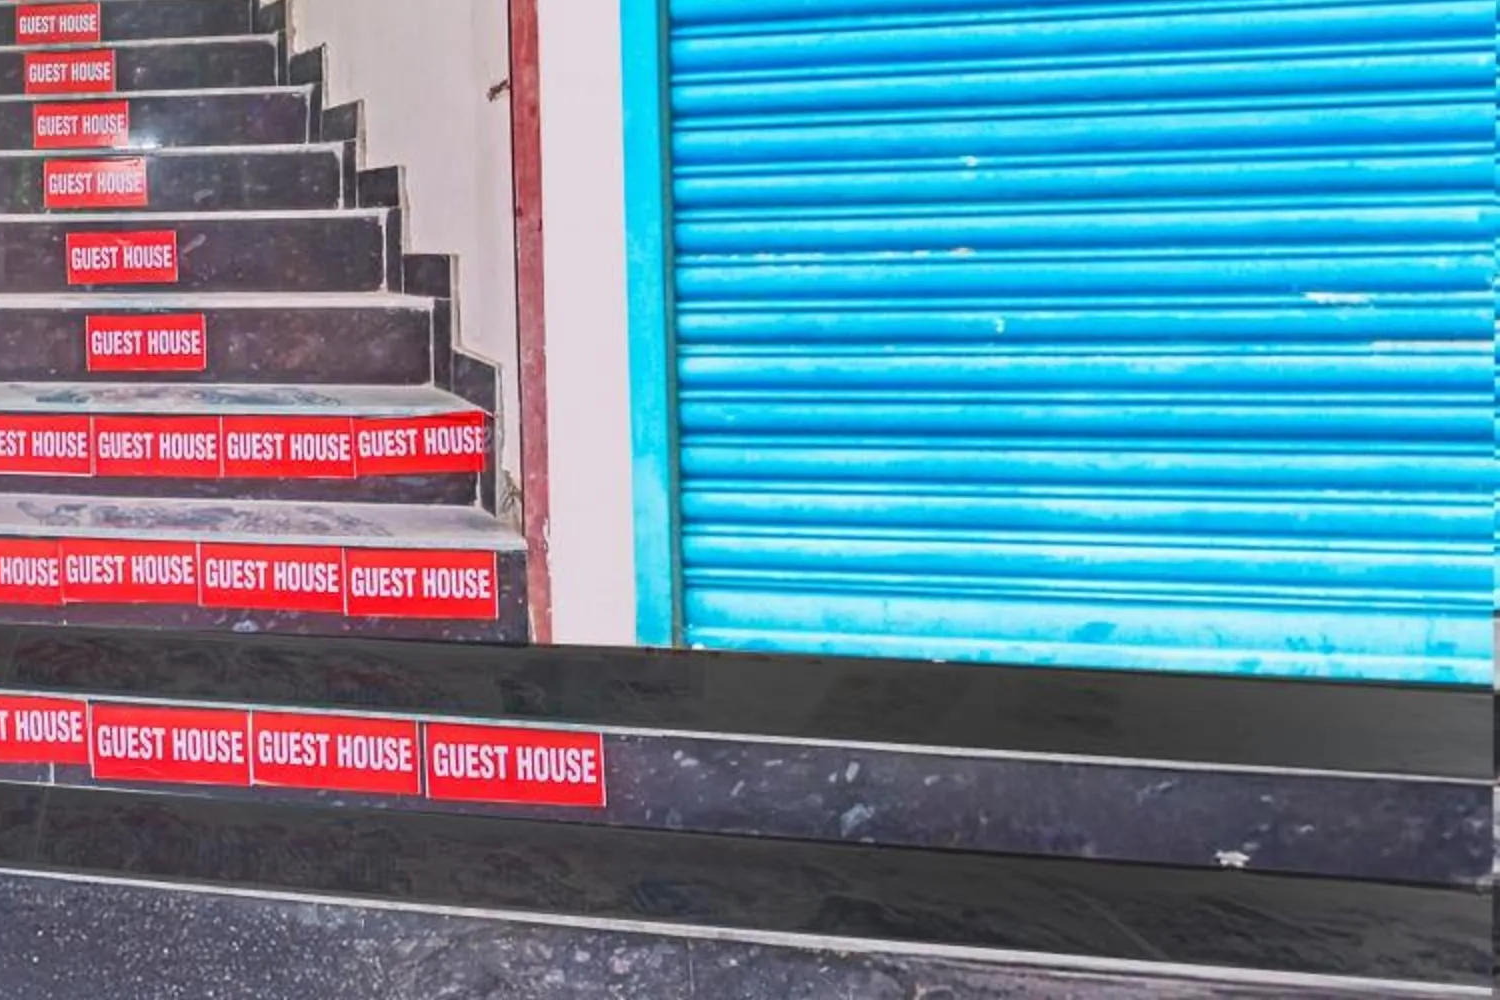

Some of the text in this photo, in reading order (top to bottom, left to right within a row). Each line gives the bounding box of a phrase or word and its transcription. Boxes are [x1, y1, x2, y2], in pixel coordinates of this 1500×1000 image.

[19, 14, 97, 34] GUEST HOUSE
[28, 61, 111, 83] GUEST HOUSE
[37, 113, 126, 136] GUEST HOUSE
[49, 171, 143, 194] GUEST HOUSE
[71, 245, 173, 271] GUEST HOUSE
[91, 329, 201, 355] GUEST HOUSE
[32, 430, 87, 457] HOUSE
[98, 431, 217, 460] GUEST HOUSE
[226, 431, 351, 461] GUEST HOUSE
[358, 425, 484, 458] GUEST HOUSE
[0, 556, 59, 586] HOUSE
[65, 554, 195, 584] GUEST HOUSE
[205, 558, 339, 593] GUEST HOUSE
[350, 567, 491, 599] GUEST HOUSE
[15, 709, 83, 744] HOUSE
[97, 725, 244, 764] GUEST HOUSE
[258, 729, 412, 772] GUEST HOUSE
[433, 741, 597, 784] GUEST HOUSE
